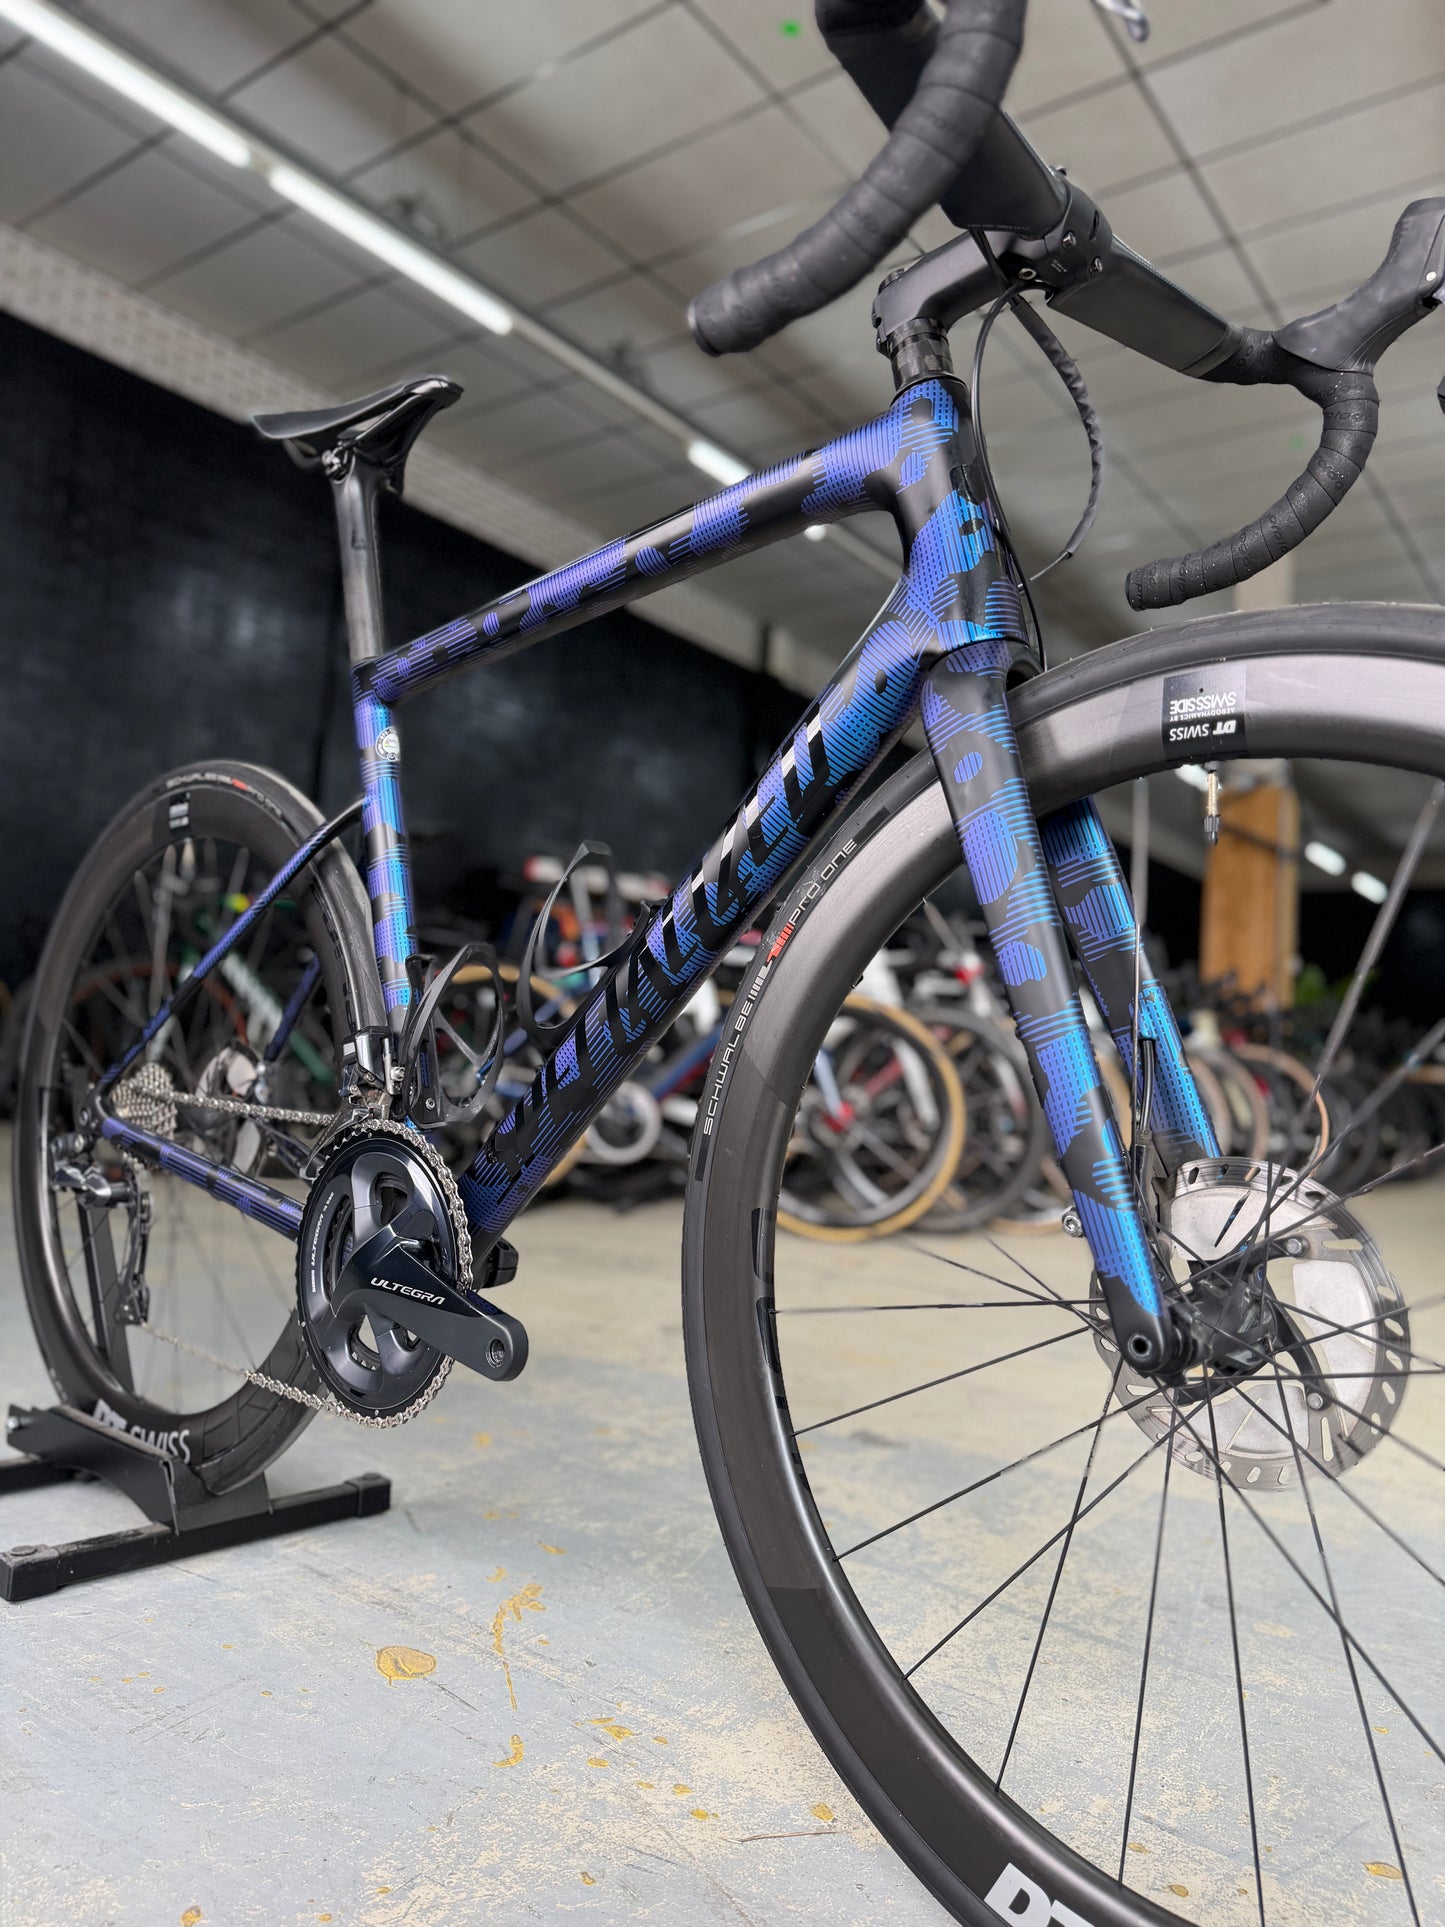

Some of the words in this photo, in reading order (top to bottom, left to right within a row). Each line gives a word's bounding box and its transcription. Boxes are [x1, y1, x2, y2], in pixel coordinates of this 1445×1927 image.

[1179, 707, 1235, 720] AERODYNAMICS
[1169, 723, 1209, 741] SWISS
[1213, 720, 1237, 735] DT
[703, 1000, 754, 1136] SCHWALBE
[311, 1213, 324, 1267] ULTEGRA
[370, 1277, 446, 1305] ULTEGRA
